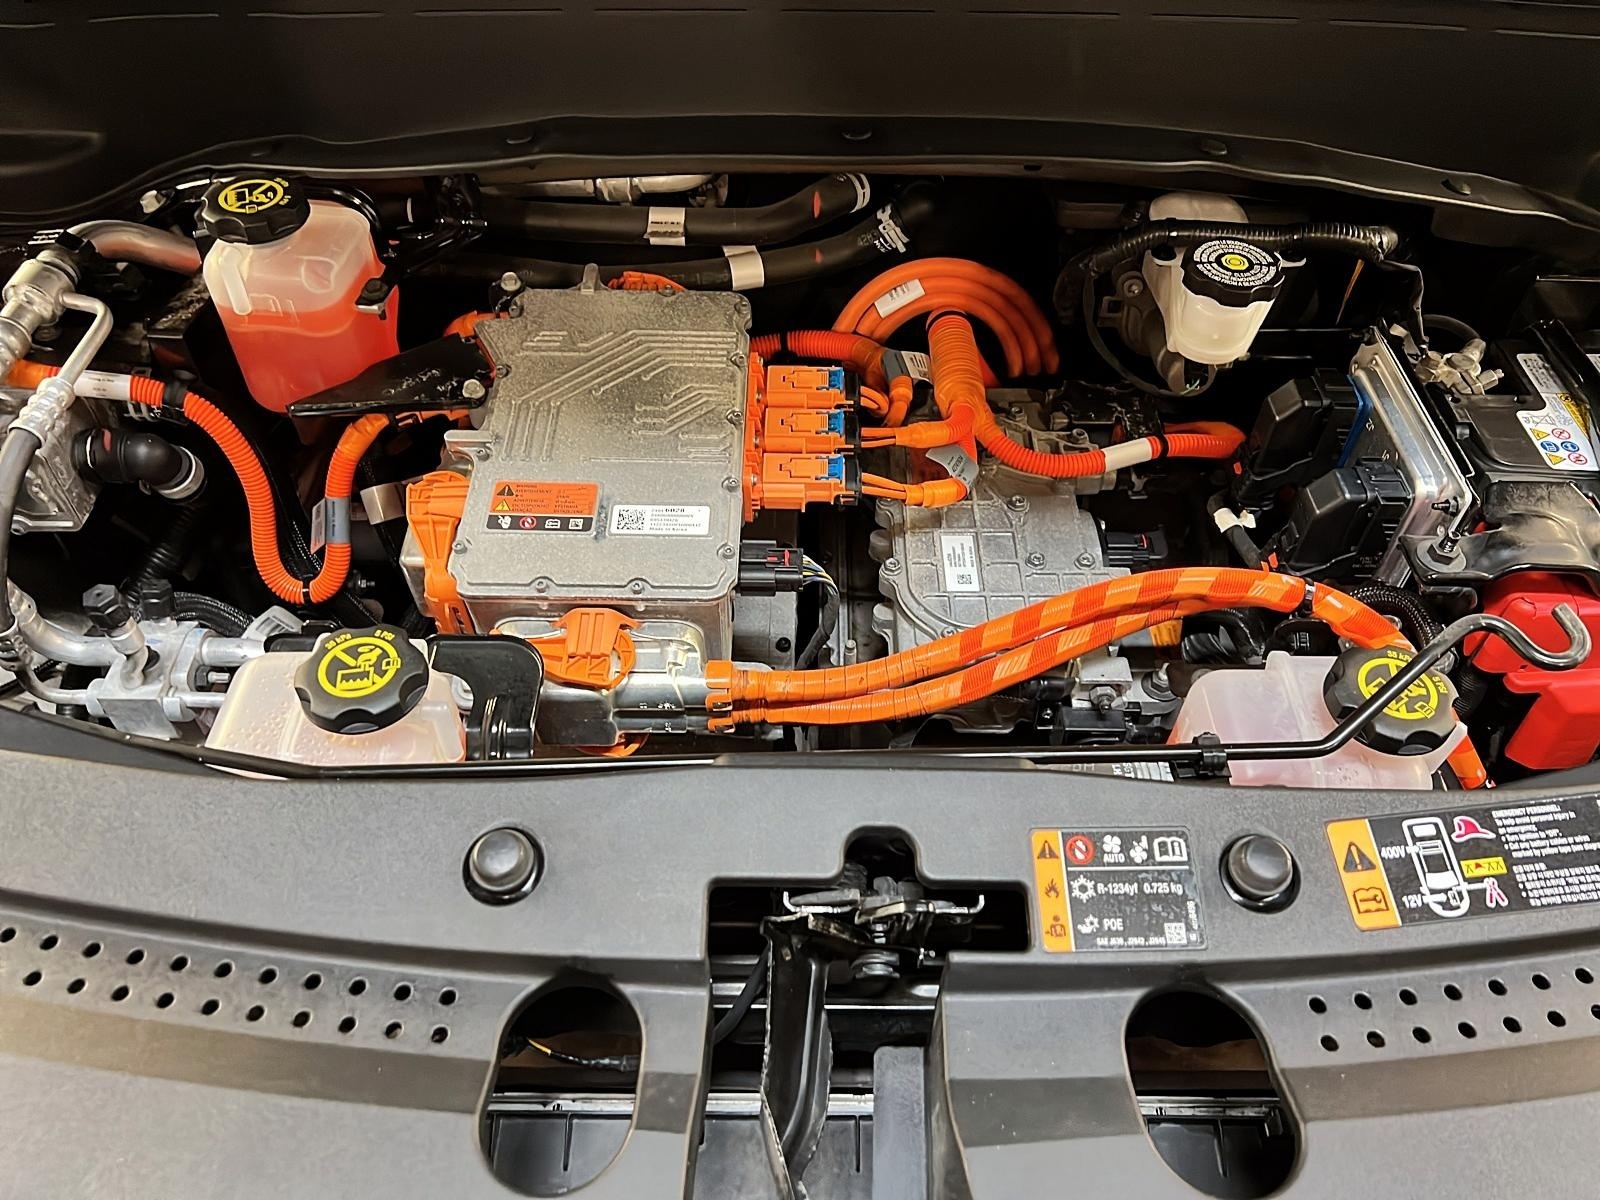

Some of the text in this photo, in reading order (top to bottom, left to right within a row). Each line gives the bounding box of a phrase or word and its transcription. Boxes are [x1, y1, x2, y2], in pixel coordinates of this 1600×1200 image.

[1103, 853, 1125, 863] AUTO
[1381, 845, 1405, 859] 400V
[1097, 881, 1183, 896] R-1234yf 0.725 kg
[1402, 894, 1422, 908] 12V
[1103, 918, 1124, 931] POE
